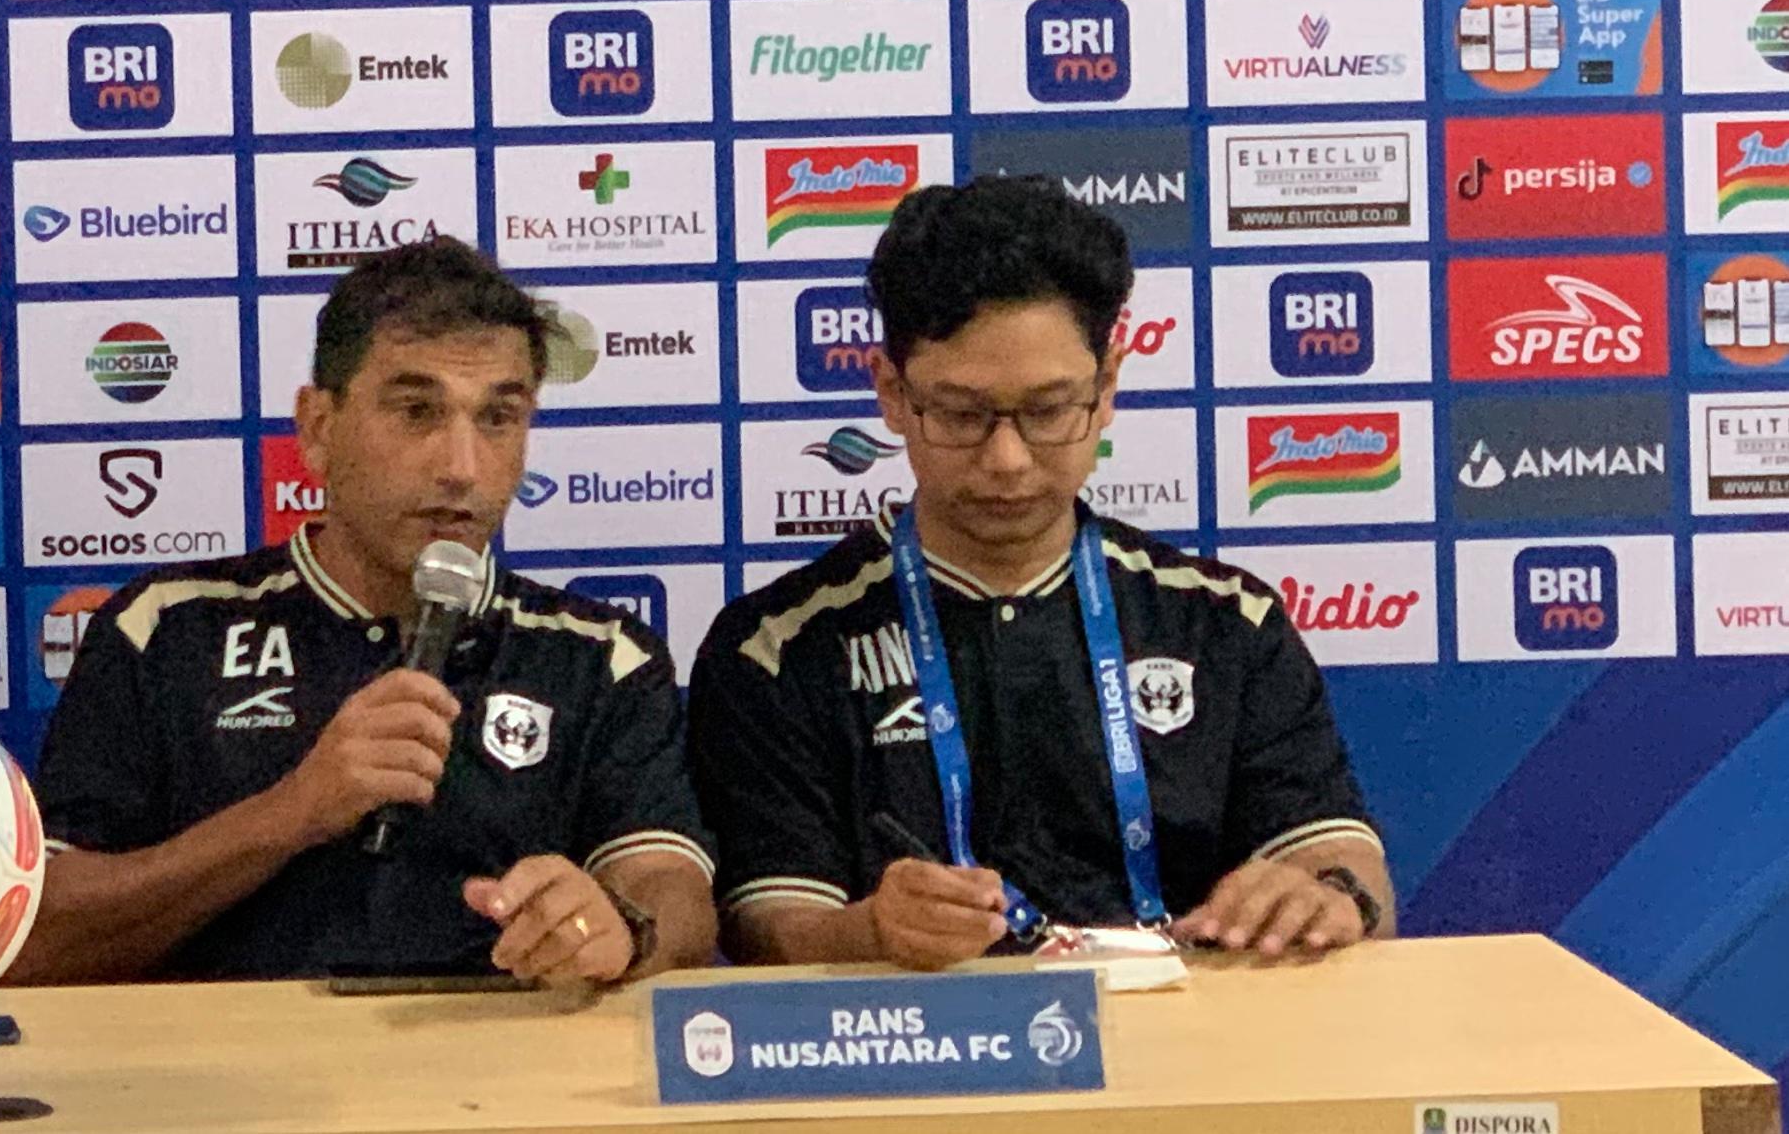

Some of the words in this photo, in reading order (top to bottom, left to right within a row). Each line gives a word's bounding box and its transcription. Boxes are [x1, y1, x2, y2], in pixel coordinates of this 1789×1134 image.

[1577, 6, 1642, 28] Super
[563, 32, 637, 68] BRI
[1041, 18, 1114, 54] BRI
[1579, 26, 1625, 47] App
[83, 45, 157, 82] BRI
[358, 53, 448, 80] Emtek
[748, 31, 931, 82] Fitogether
[1224, 56, 1406, 79] VIRTUALNESS
[1237, 146, 1396, 167] ELITECLUB
[1062, 170, 1186, 209] MMAN
[1503, 159, 1615, 194] persija
[81, 202, 226, 238] Bluebird
[506, 214, 556, 239] EKA
[565, 209, 704, 236] HOSPITAL
[809, 307, 882, 343] BRI
[1284, 292, 1356, 329] BRI
[605, 330, 695, 356] Emtek
[1491, 324, 1641, 366] SPECS
[86, 353, 178, 372] INDOSIAR
[1512, 442, 1663, 478] AMMAN
[568, 469, 712, 505] Bluebird
[775, 486, 903, 519] ITHAC
[1529, 567, 1600, 603] BRI
[222, 621, 295, 678] EA
[831, 1006, 925, 1037] RANS
[751, 1037, 961, 1068] NUSANTARA
[969, 1034, 1012, 1062] FC
